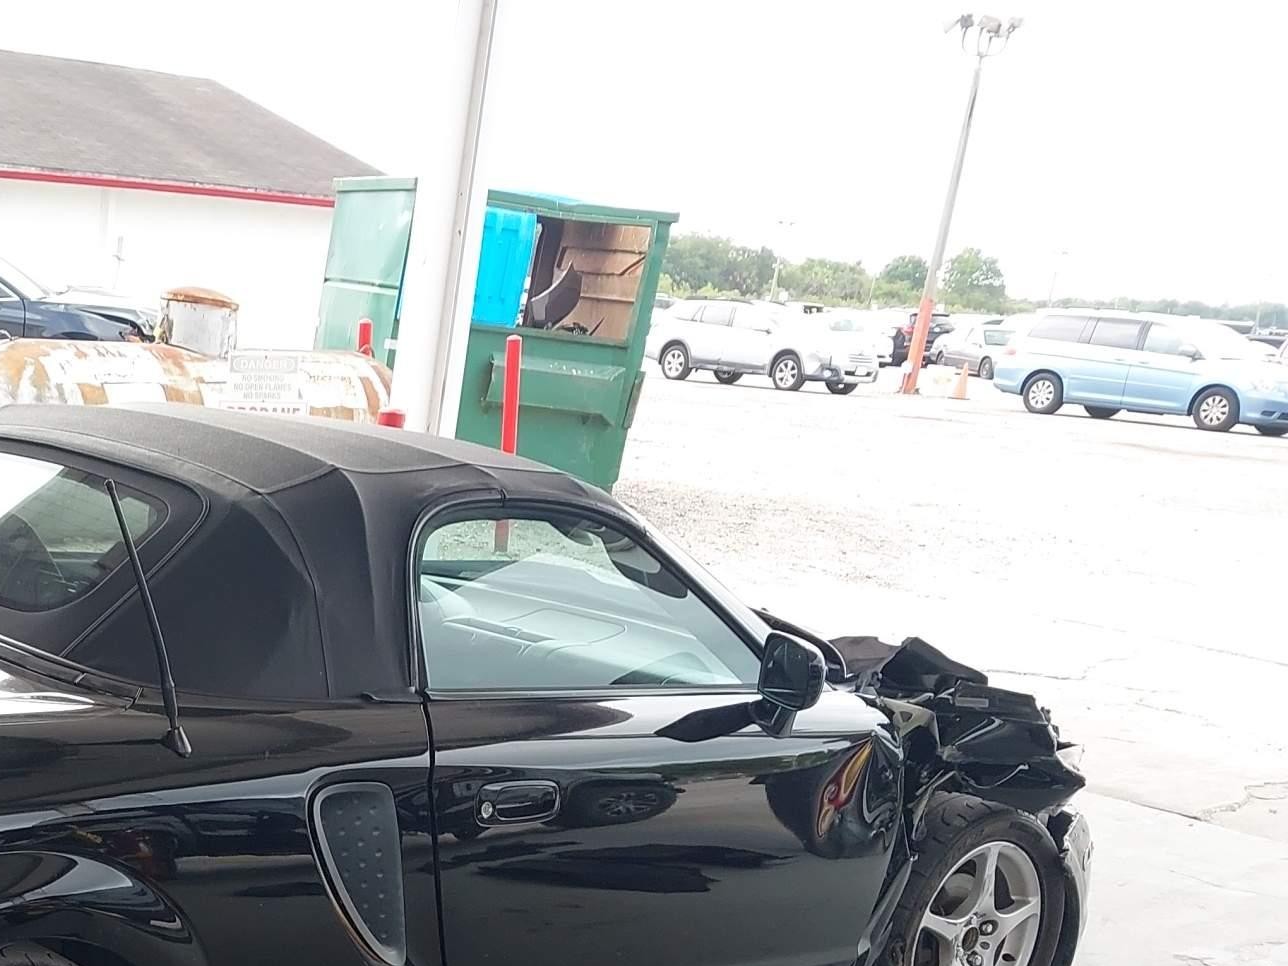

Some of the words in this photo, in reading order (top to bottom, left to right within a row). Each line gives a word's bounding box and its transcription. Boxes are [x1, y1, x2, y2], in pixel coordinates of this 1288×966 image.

[240, 359, 288, 369] DANGER
[242, 374, 252, 382] NO
[253, 374, 286, 382] SMOKING
[233, 383, 243, 392] NO
[245, 383, 264, 392] OPEN
[265, 383, 293, 392] FLAMES
[243, 391, 253, 400] NO
[255, 391, 281, 400] SPARKS
